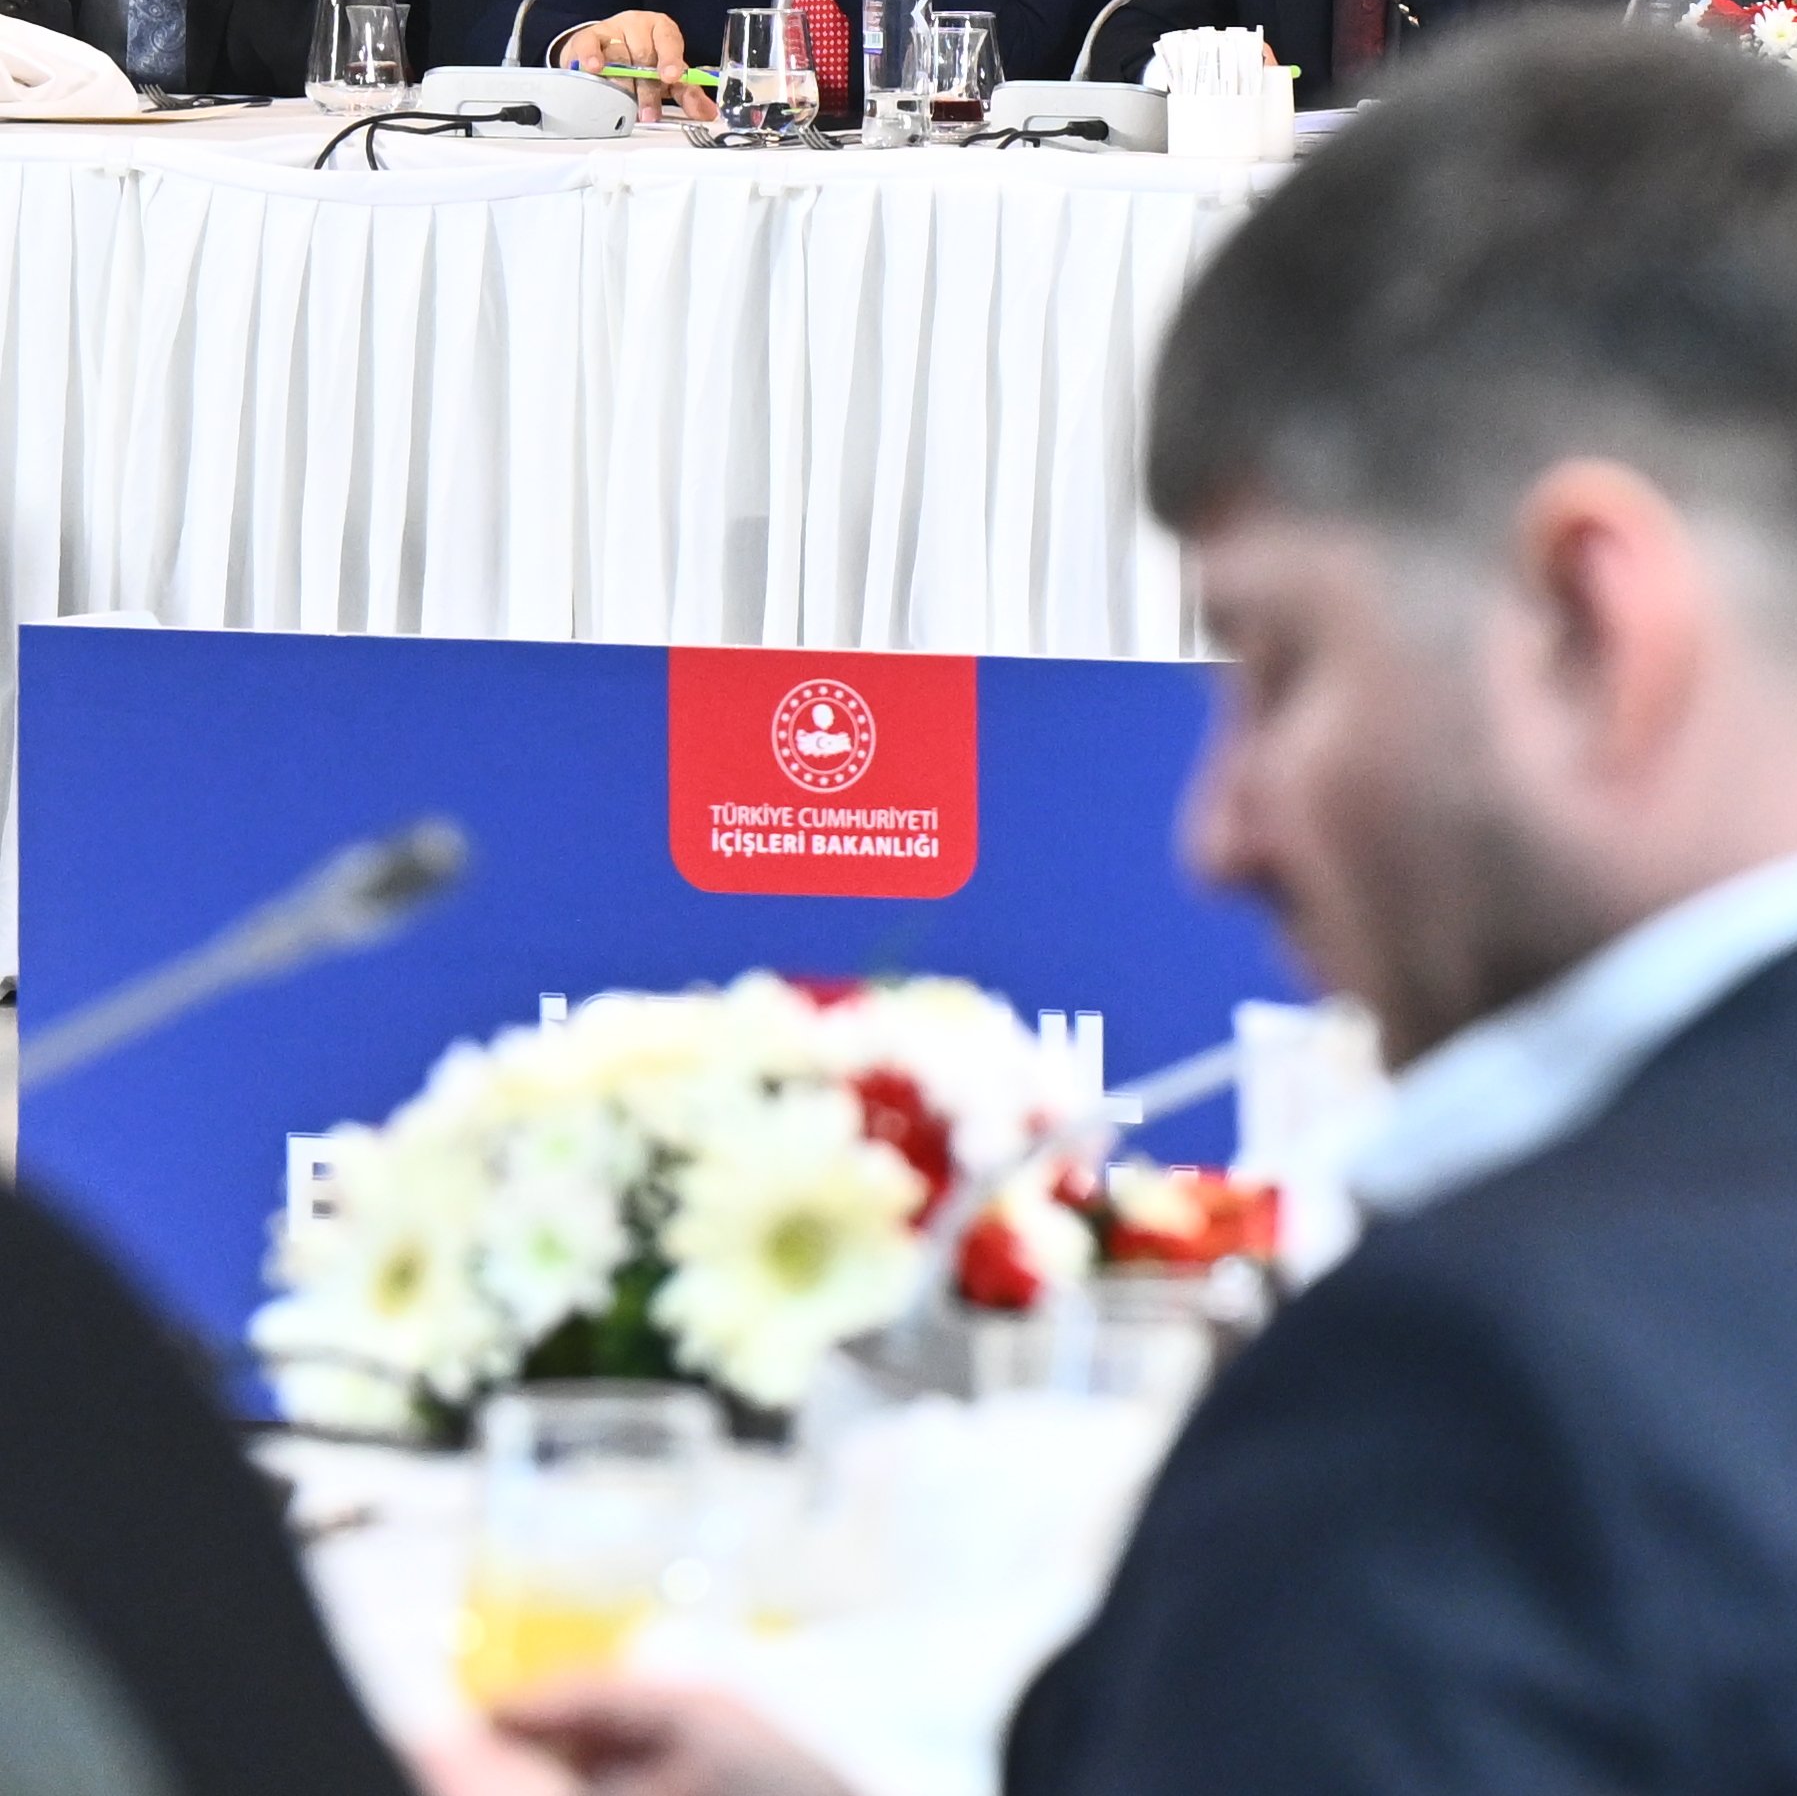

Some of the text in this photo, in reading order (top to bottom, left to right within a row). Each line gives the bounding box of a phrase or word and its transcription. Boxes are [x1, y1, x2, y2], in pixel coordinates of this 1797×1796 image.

[709, 801, 938, 831] TÜRKİYE CUMHURİYETİ
[711, 828, 939, 858] İÇİŞLERİ BAKANLIĞI
